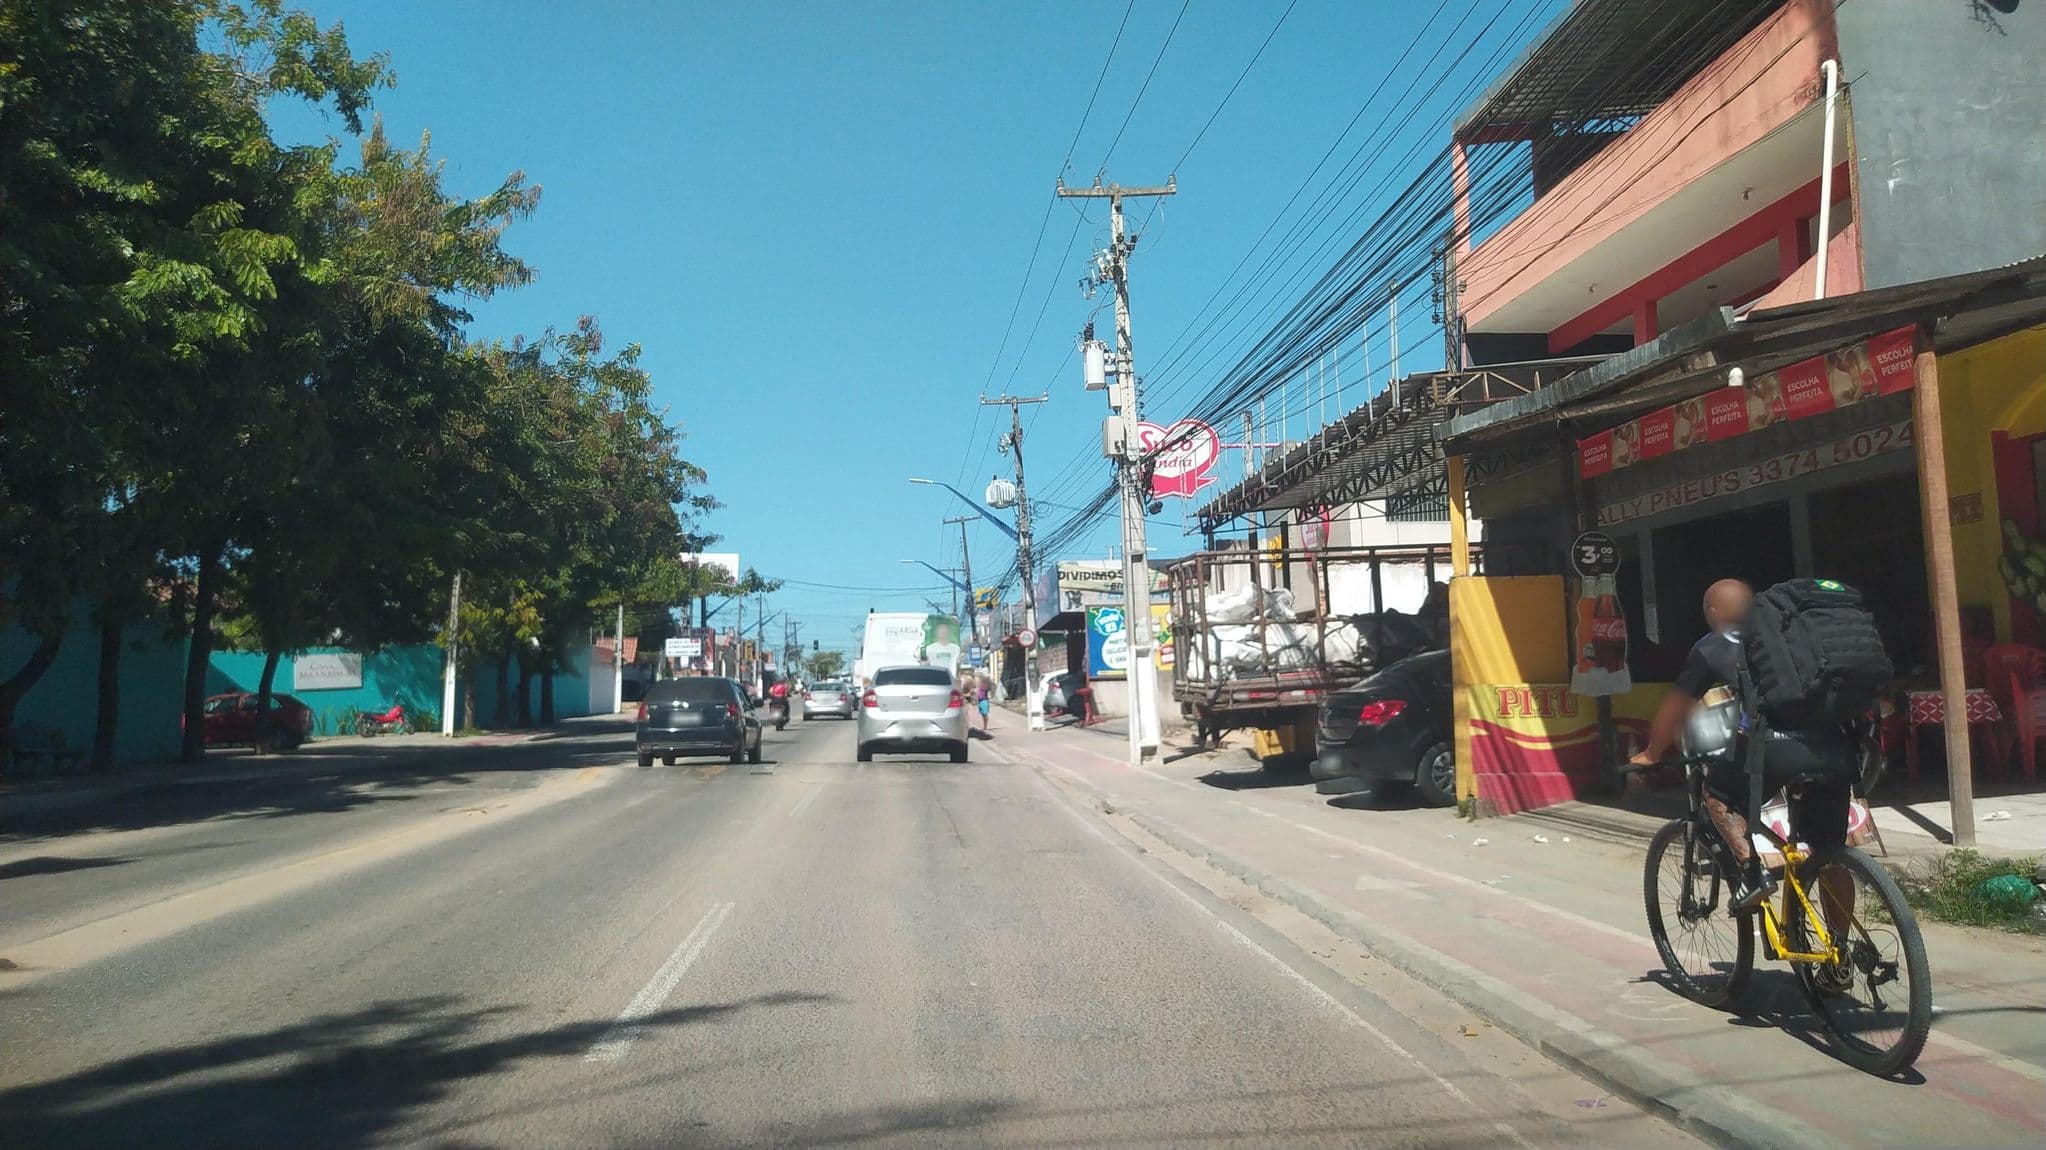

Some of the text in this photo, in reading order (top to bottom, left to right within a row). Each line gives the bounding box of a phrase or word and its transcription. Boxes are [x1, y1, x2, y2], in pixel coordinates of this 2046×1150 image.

[1876, 344, 1914, 364] ESCOLHA
[1880, 359, 1914, 377] PERFEIT
[1786, 376, 1820, 393] ESCOLHA
[1790, 388, 1824, 402] PERFEITA
[1711, 401, 1740, 416] ESCOLHA
[1711, 411, 1742, 426] PERFEITA
[1644, 422, 1670, 436] ESCOLHA
[1644, 432, 1670, 445] PERFEITA
[1750, 454, 1823, 488] 3374
[1832, 423, 1914, 464] 5024
